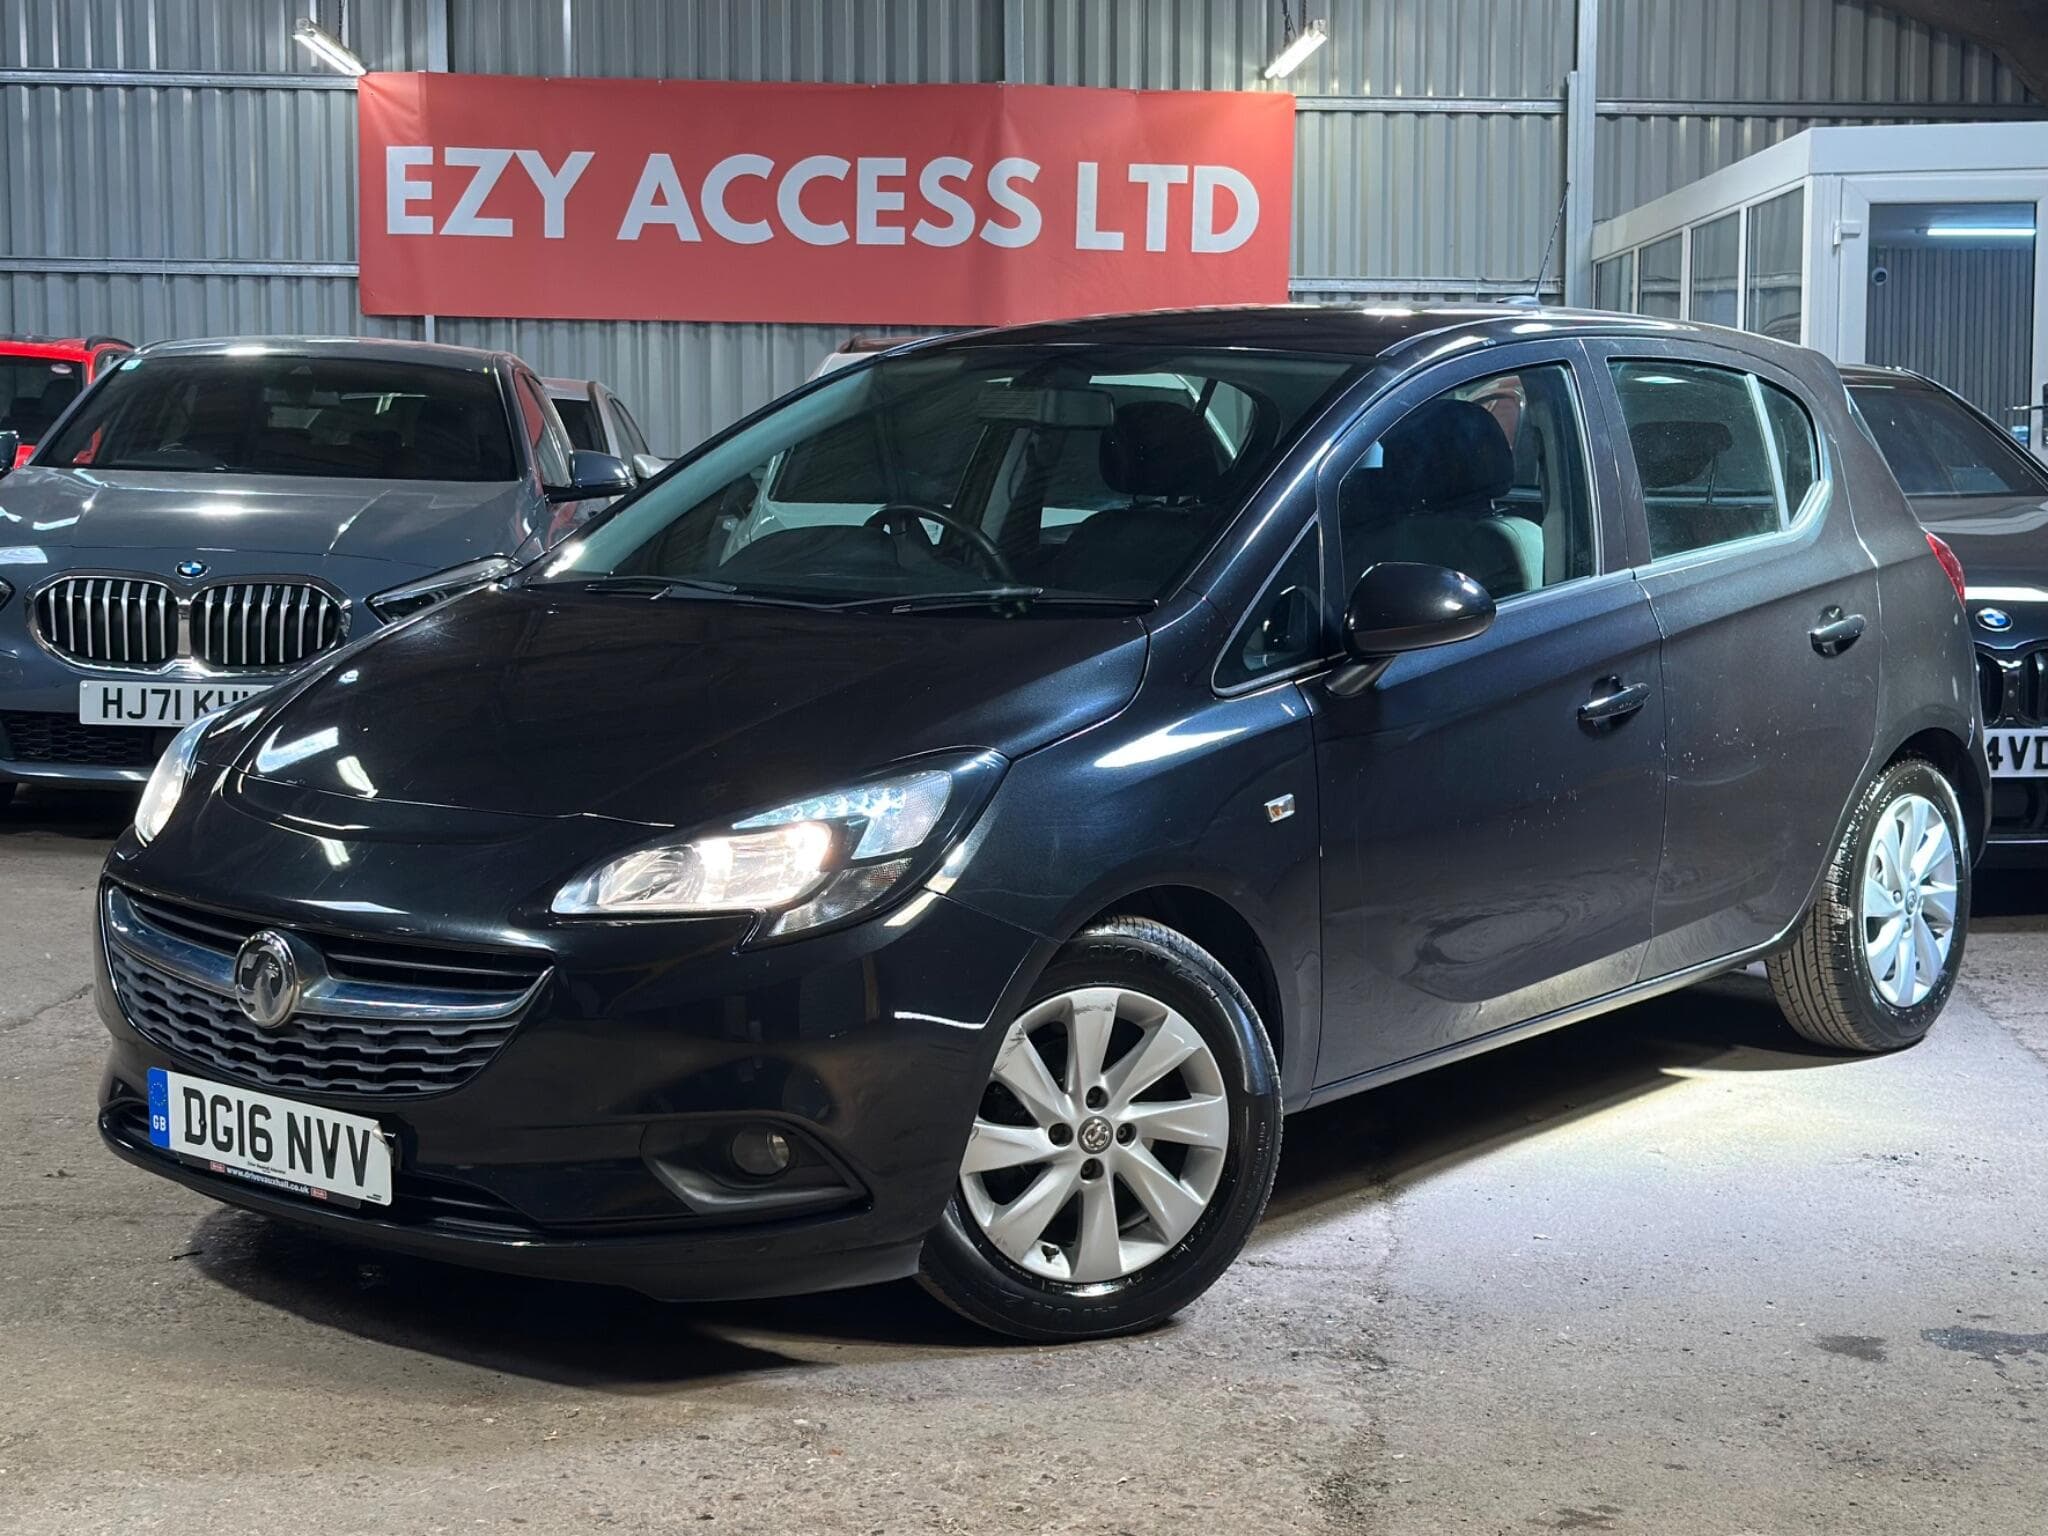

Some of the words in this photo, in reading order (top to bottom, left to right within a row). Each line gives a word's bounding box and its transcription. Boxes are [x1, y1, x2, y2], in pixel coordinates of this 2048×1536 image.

[385, 145, 596, 240] EZY
[616, 152, 1043, 249] ACCESS
[1075, 161, 1260, 254] LTD
[102, 686, 181, 721] HJ71
[193, 689, 252, 719] KH
[152, 1114, 167, 1132] GB
[183, 1087, 273, 1163] DG16
[286, 1111, 371, 1188] NVV
